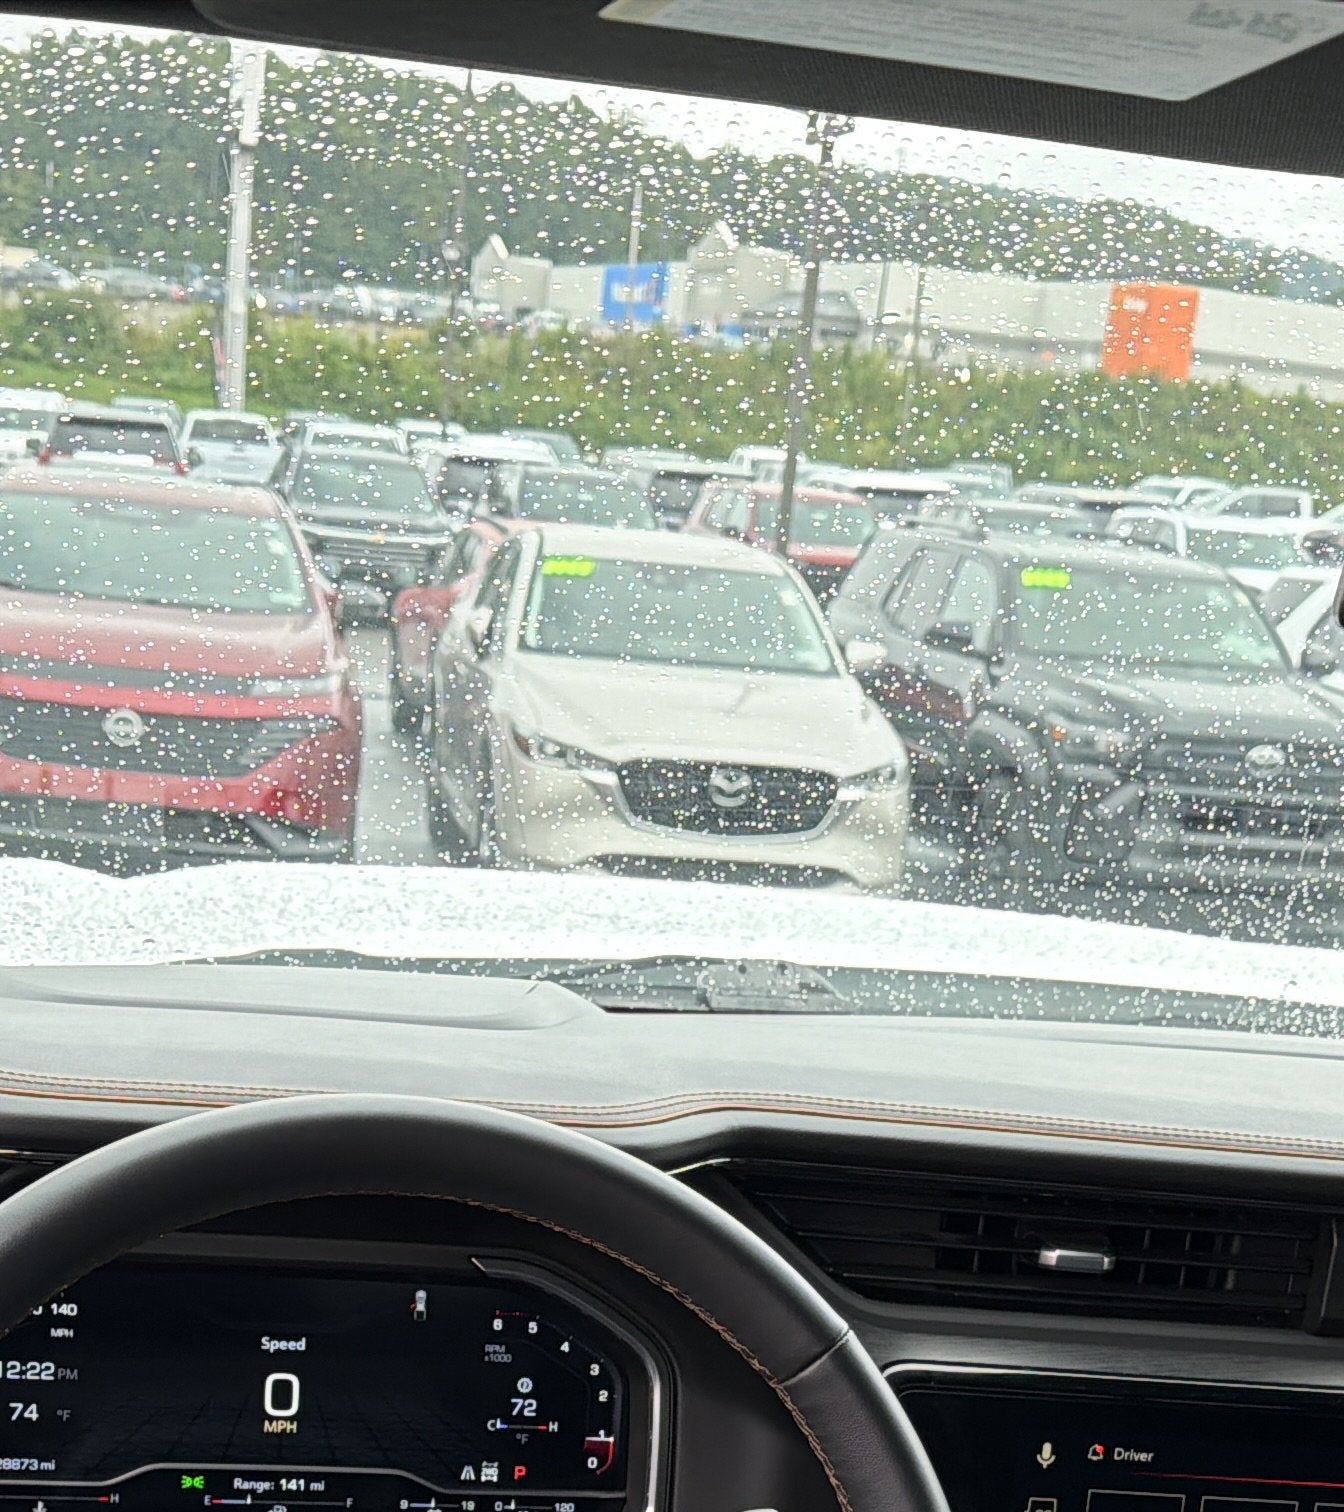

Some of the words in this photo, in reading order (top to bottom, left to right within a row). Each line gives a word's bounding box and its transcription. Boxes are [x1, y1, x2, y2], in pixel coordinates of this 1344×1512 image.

[50, 1303, 78, 1316] 140
[493, 1318, 503, 1331] 6
[528, 1321, 538, 1334] 5
[50, 1328, 74, 1338] MPH
[260, 1336, 306, 1353] Speed
[484, 1344, 506, 1353] RPM
[560, 1342, 570, 1353] 4
[57, 1368, 79, 1381] PM
[589, 1364, 600, 1376] 3
[263, 1373, 300, 1417] 0
[598, 1390, 609, 1402] 2
[9, 1402, 40, 1421] 74
[56, 1409, 72, 1422] °F
[510, 1398, 537, 1417] 72
[263, 1420, 298, 1433] MPH
[548, 1421, 559, 1432] H
[1113, 1446, 1155, 1463] Driver
[40, 1459, 56, 1471] mi
[587, 1456, 598, 1469] 0
[514, 1465, 528, 1480] P
[233, 1477, 275, 1494] Range:
[279, 1478, 305, 1491] 141
[309, 1481, 326, 1491] mi
[109, 1493, 120, 1503] H
[204, 1495, 212, 1506] E
[346, 1498, 354, 1508] F
[400, 1500, 409, 1510] 9
[494, 1501, 504, 1512] 0
[554, 1503, 575, 1512] 120
